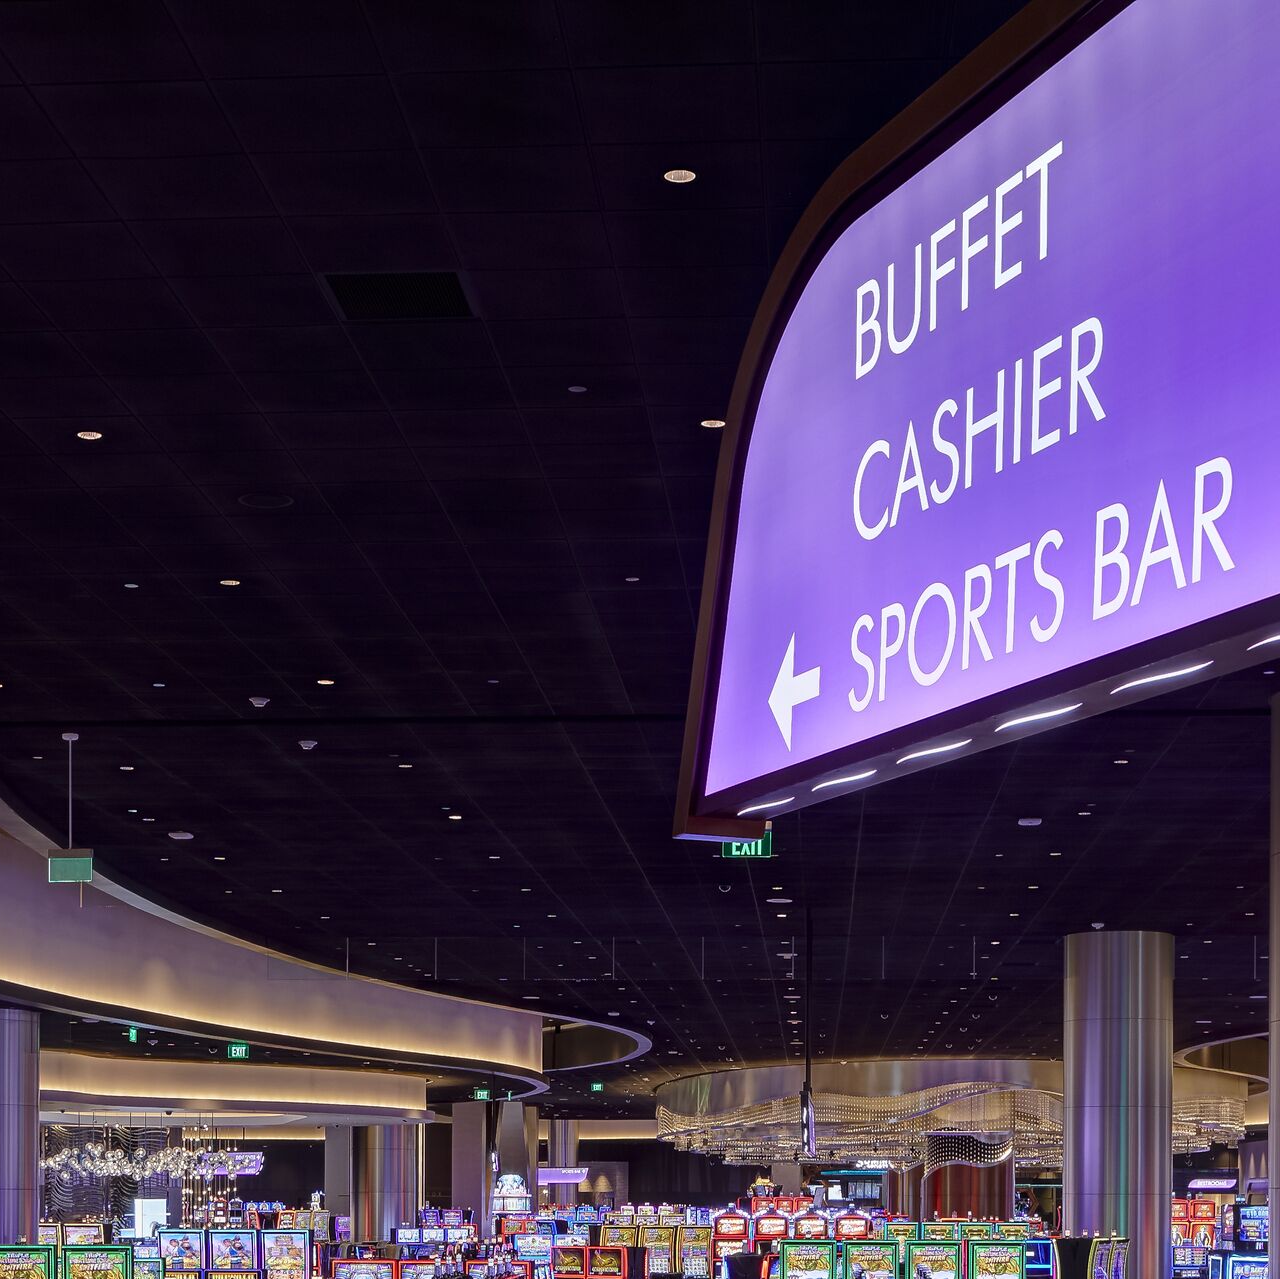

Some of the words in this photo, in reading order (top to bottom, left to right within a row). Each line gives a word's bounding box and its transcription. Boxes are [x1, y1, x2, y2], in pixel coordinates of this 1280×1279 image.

[856, 141, 1063, 380] BUFFET
[852, 316, 1106, 541] CASHIER
[848, 529, 1064, 713] SPORTS
[1092, 456, 1236, 620] BAR
[231, 1046, 246, 1056] EXIT
